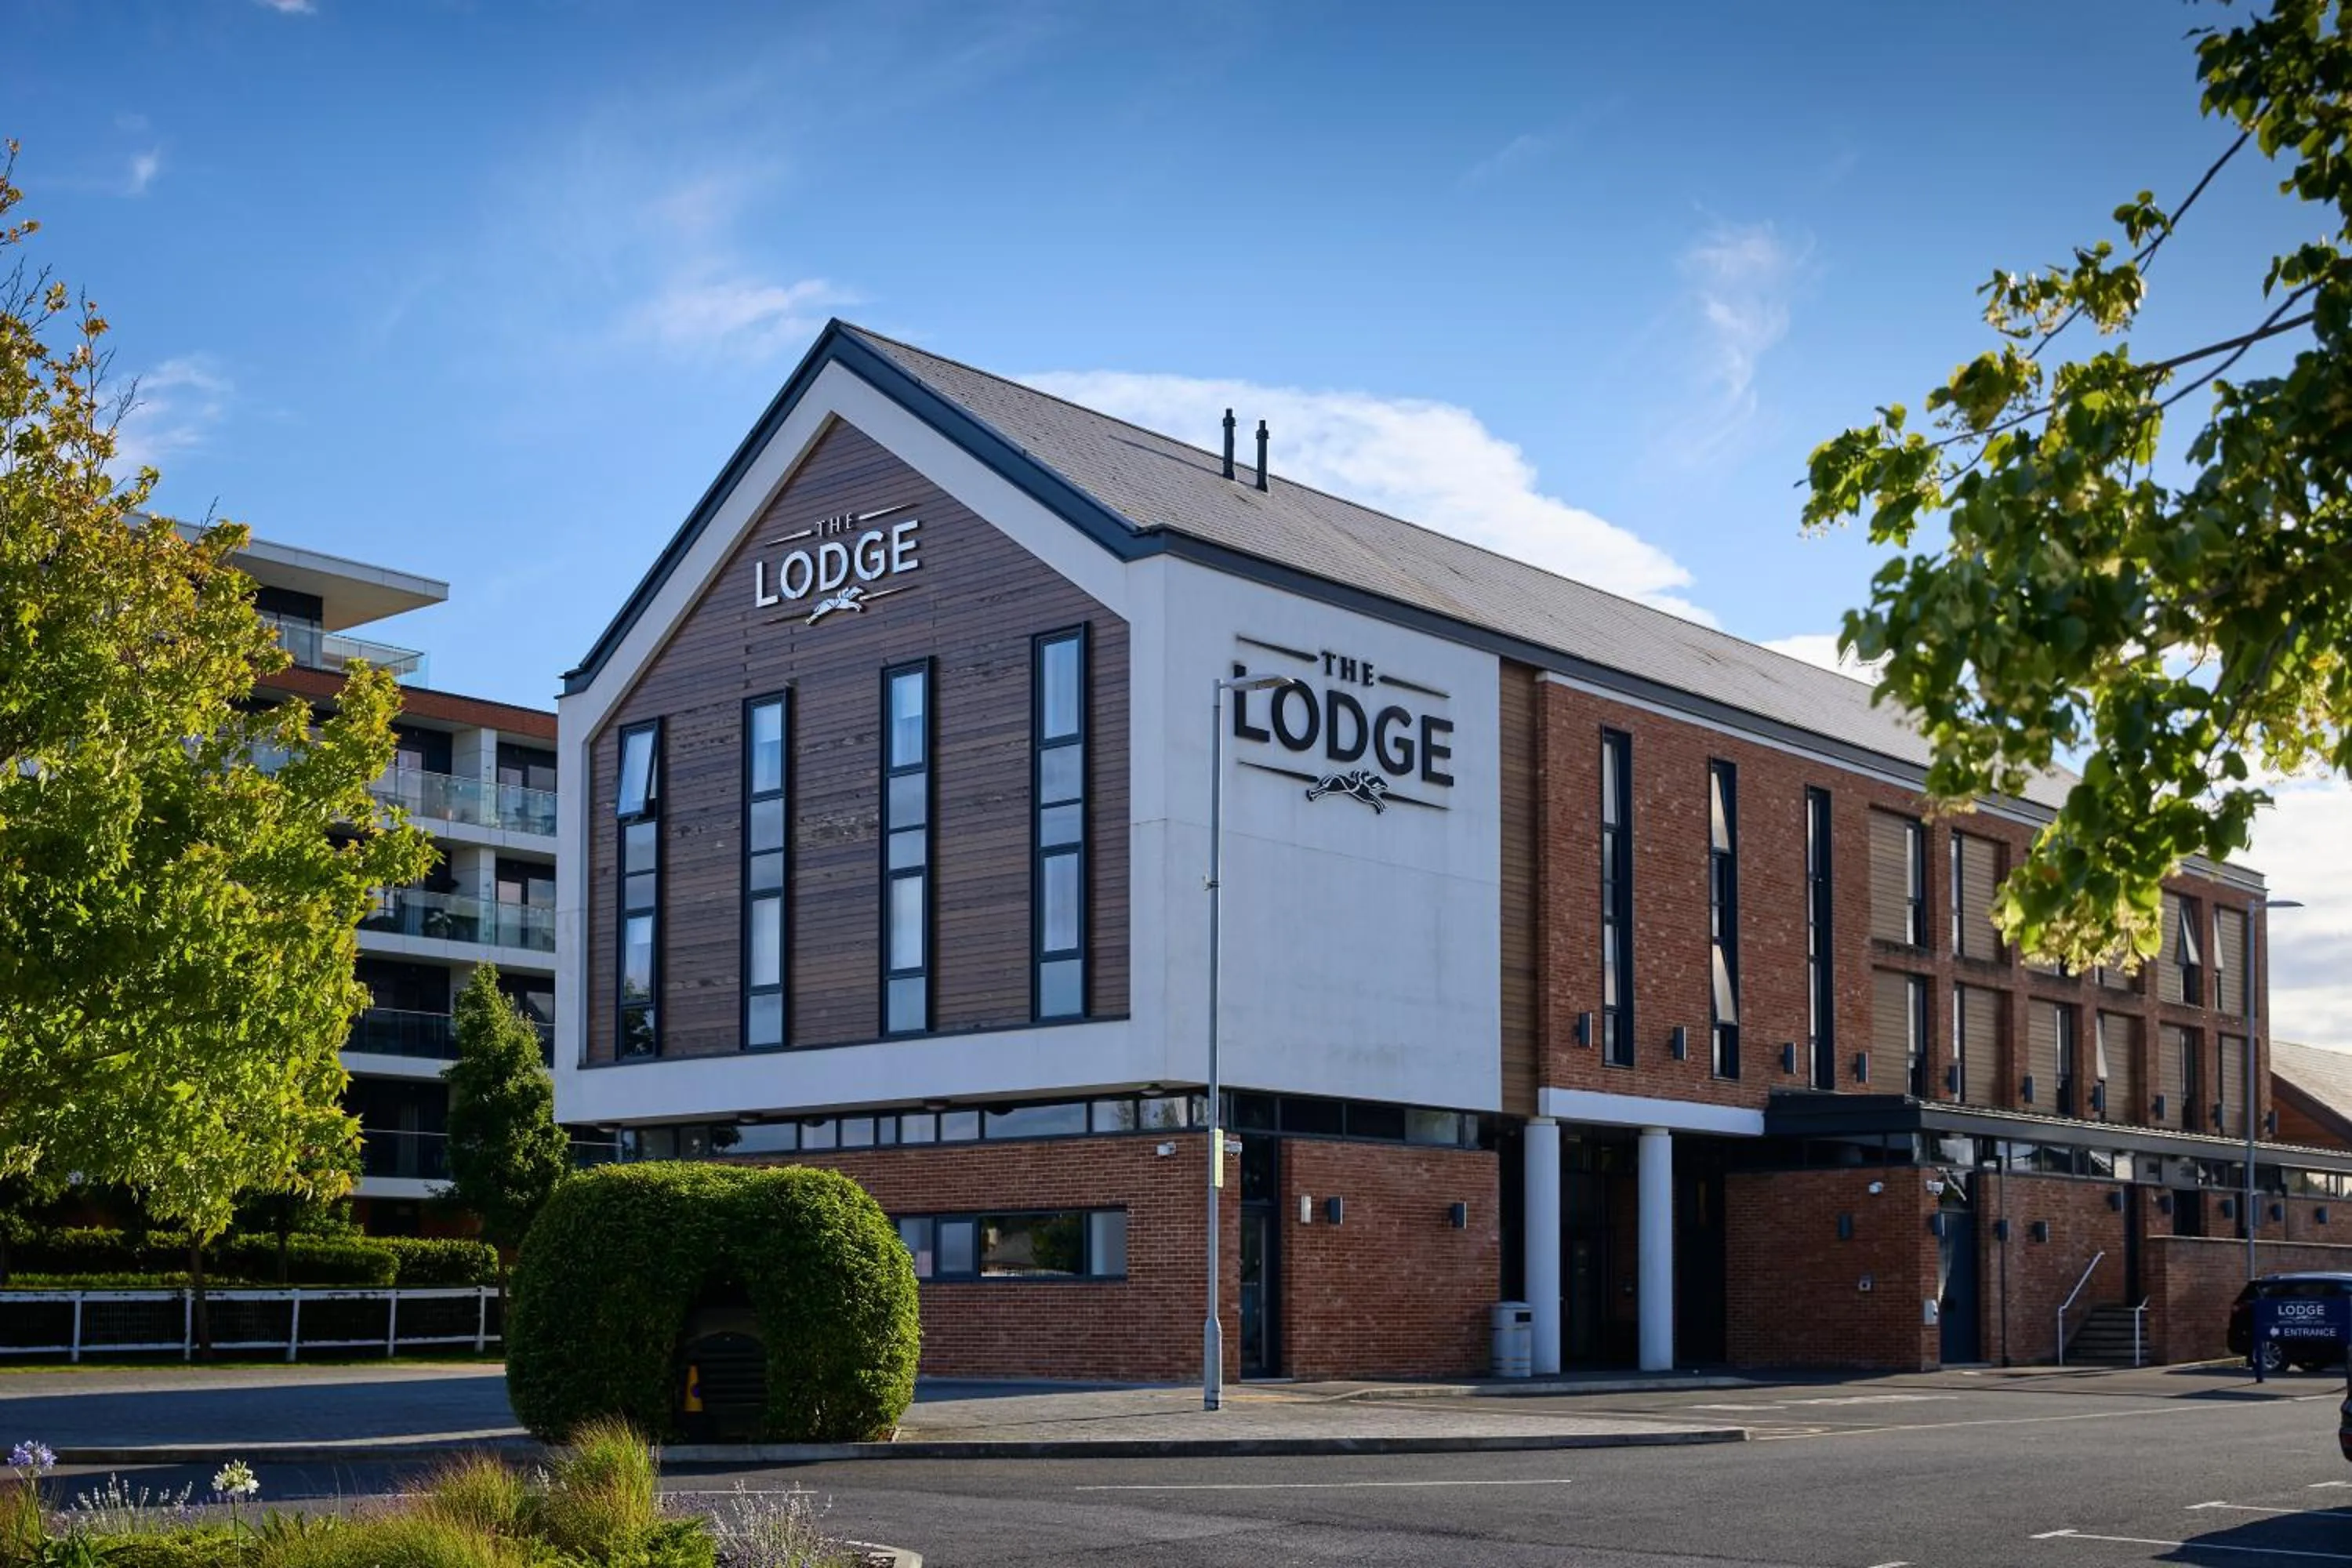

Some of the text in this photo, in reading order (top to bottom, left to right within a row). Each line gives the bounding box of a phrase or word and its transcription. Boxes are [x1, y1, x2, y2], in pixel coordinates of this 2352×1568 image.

[815, 512, 853, 537] THE
[755, 519, 920, 608] LODGE
[1320, 650, 1374, 687] THE
[1233, 663, 1454, 787] LODGE
[2278, 1305, 2325, 1316] LODGE
[2284, 1327, 2337, 1337] ENTRANCE
